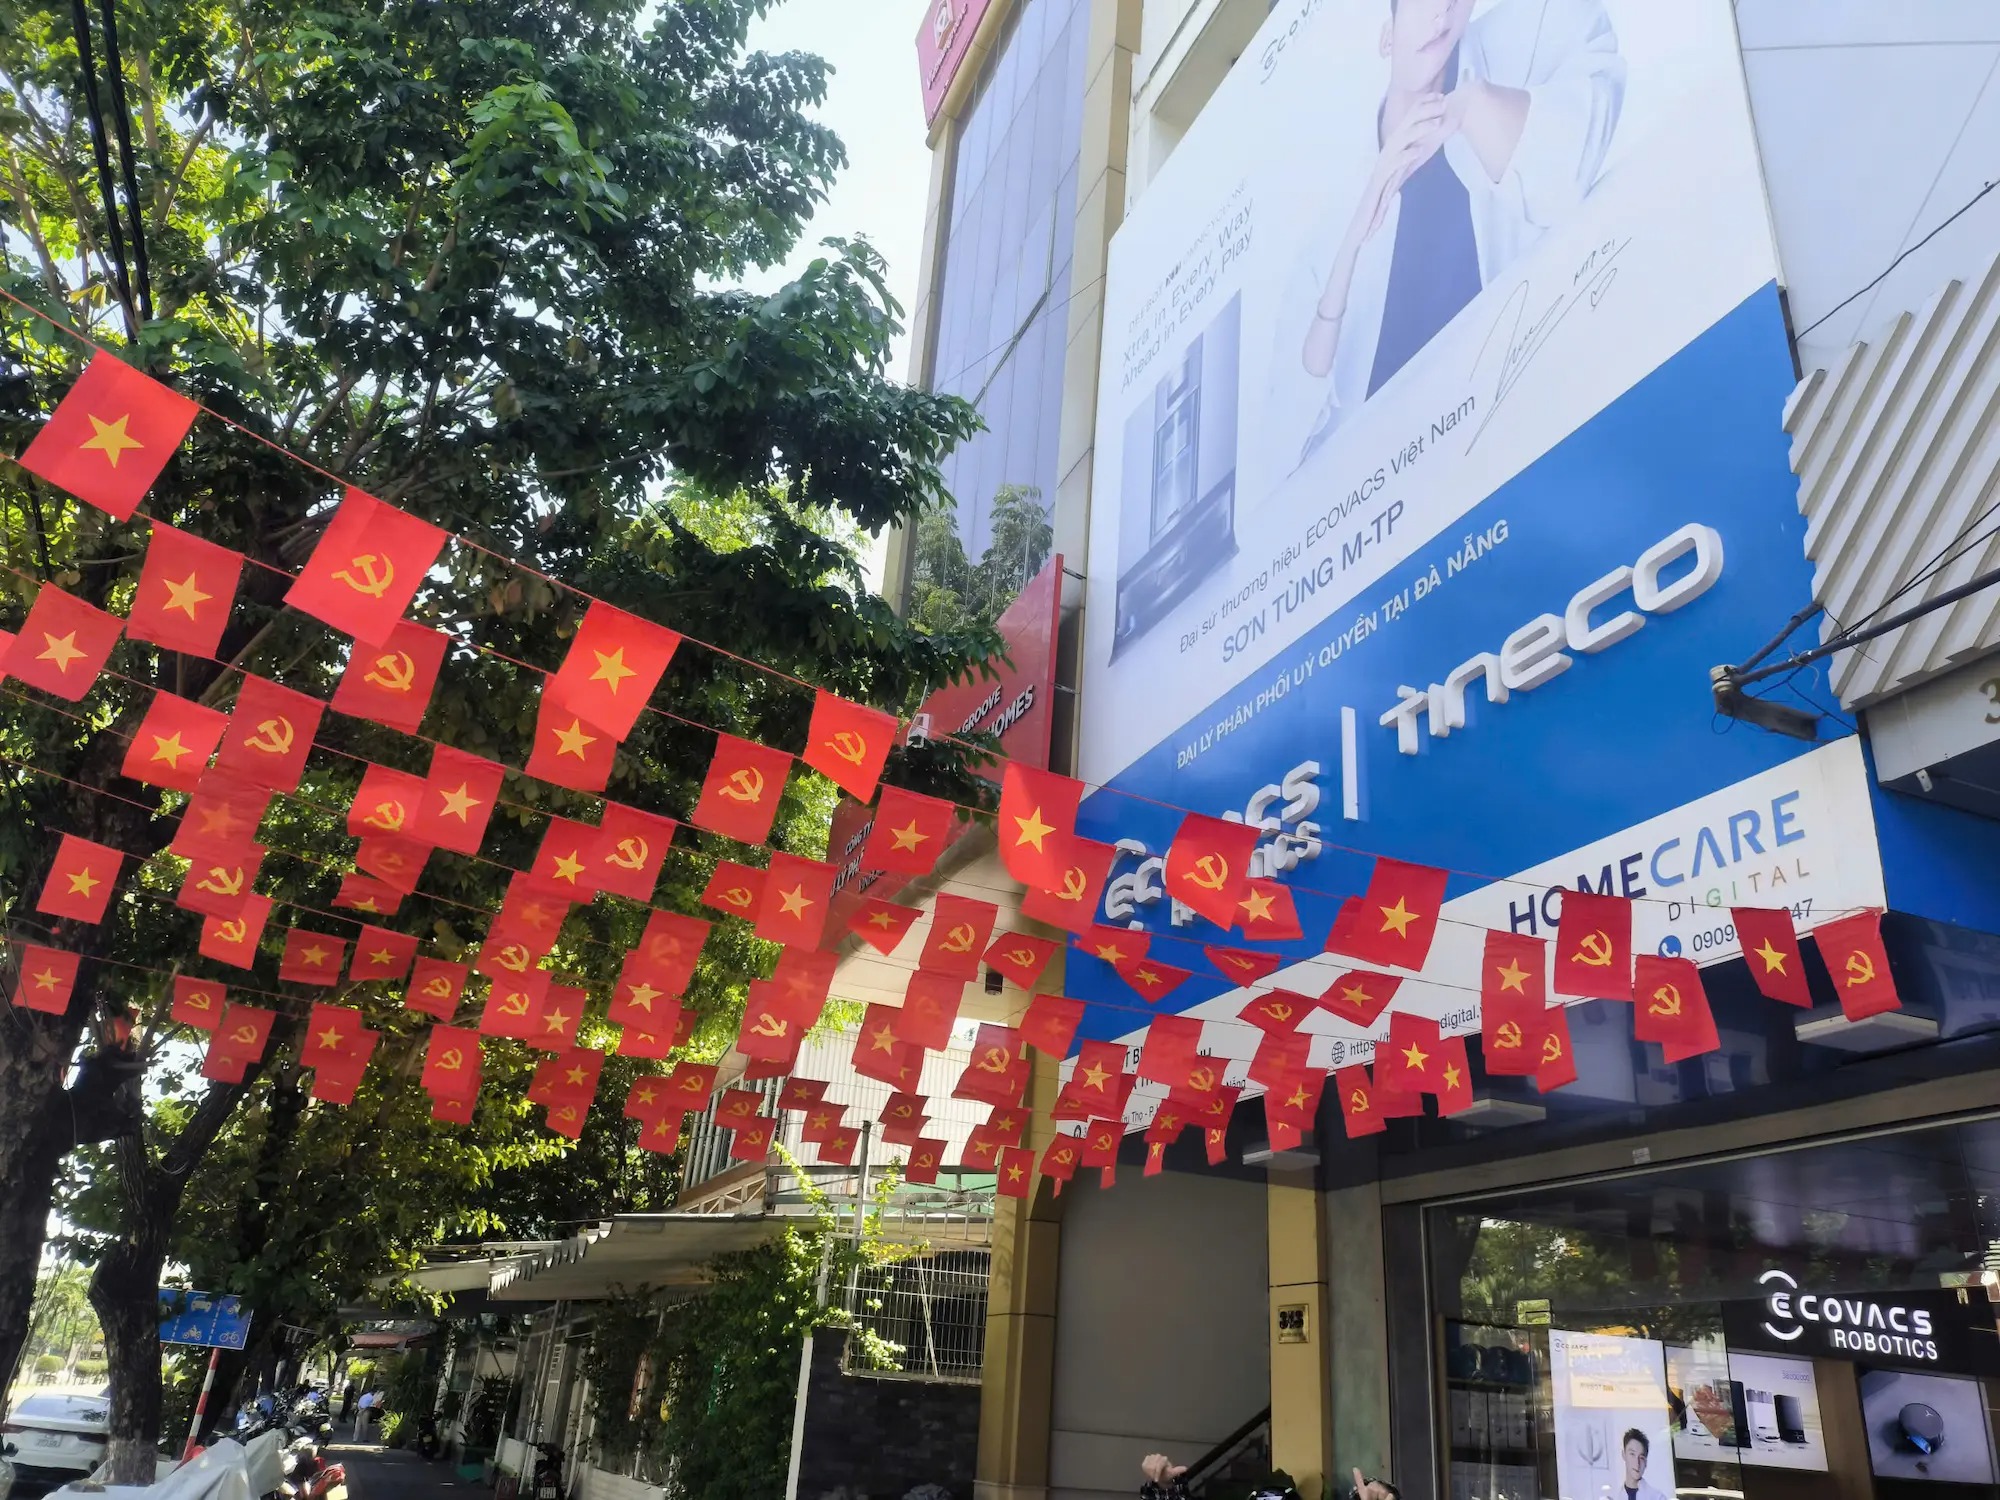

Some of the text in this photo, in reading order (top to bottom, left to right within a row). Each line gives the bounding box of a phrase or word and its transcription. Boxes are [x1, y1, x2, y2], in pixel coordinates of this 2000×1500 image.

[1121, 340, 1161, 395] Ahead
[1164, 319, 1176, 344] in
[1179, 269, 1218, 325] Every
[1222, 225, 1254, 276] Play
[1123, 327, 1150, 367] Xtra
[1154, 307, 1166, 329] in
[1171, 250, 1213, 309] Every
[1217, 197, 1254, 249] Way
[1221, 571, 1269, 618] thương
[1272, 541, 1302, 577] hiệu
[1306, 468, 1386, 550] ECOVACS
[1390, 435, 1425, 476] Việt
[1431, 396, 1476, 445] Nam
[1222, 498, 1405, 664] SƠN TÙNG M-TP
[962, 684, 1003, 734] GROOVE
[1177, 518, 1510, 770] ĐẠI LÝ PHÂN PHỐI UỶ QUYỀN TẠI ĐÀ NẴNG
[1105, 759, 1321, 920] ECCS
[1667, 857, 1811, 922] DIGITAL
[1770, 1289, 1933, 1337] ECOVACS
[1832, 1328, 1939, 1361] ROBOTICS
